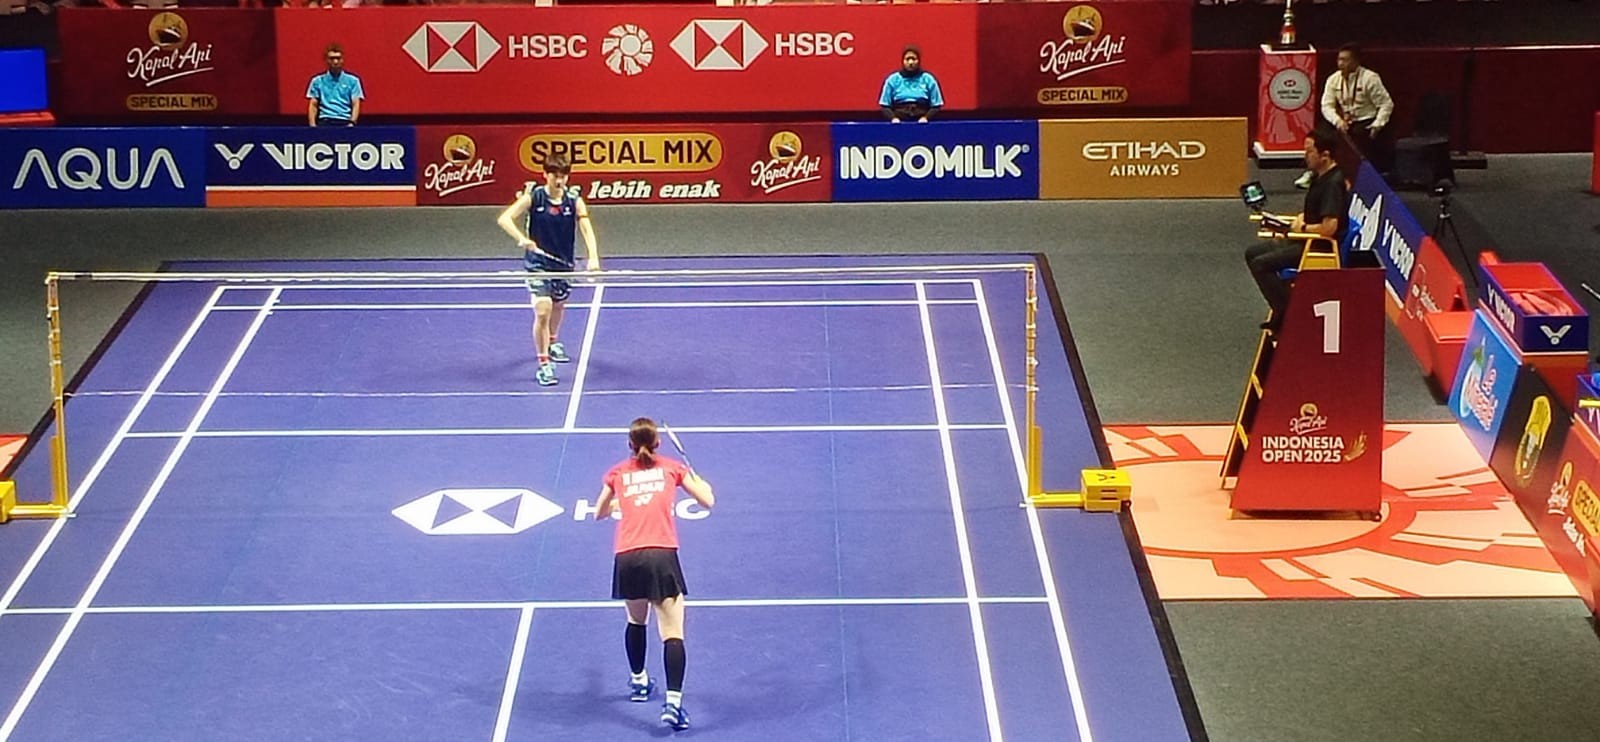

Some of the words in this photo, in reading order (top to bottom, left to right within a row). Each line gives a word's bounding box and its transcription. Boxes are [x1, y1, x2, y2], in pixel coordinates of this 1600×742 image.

[508, 35, 587, 58] HSBC
[775, 33, 854, 56] HSBC
[1040, 39, 1092, 74] Kapal
[1090, 34, 1126, 62] Api
[127, 46, 179, 80] Kapal
[178, 42, 212, 69] Api
[131, 96, 187, 108] SPECIAL
[191, 96, 215, 108] MIX
[1042, 90, 1098, 101] SPECIAL
[1101, 89, 1125, 100] MIX
[262, 142, 405, 170] VICTOR
[664, 140, 723, 164] MIX
[1082, 140, 1207, 159] ETIHAD
[12, 147, 185, 190] AQUA
[424, 162, 468, 191] Kapal
[466, 159, 496, 182] Api
[751, 159, 794, 188] Kapal
[792, 155, 821, 178] Api
[1110, 165, 1180, 176] AIRWAYS
[587, 180, 654, 199] lebih
[659, 179, 721, 198] enak
[1313, 300, 1341, 353] 1
[1262, 436, 1345, 449] INDONESIA
[1262, 449, 1303, 463] OPEN
[1303, 449, 1341, 463] 2025
